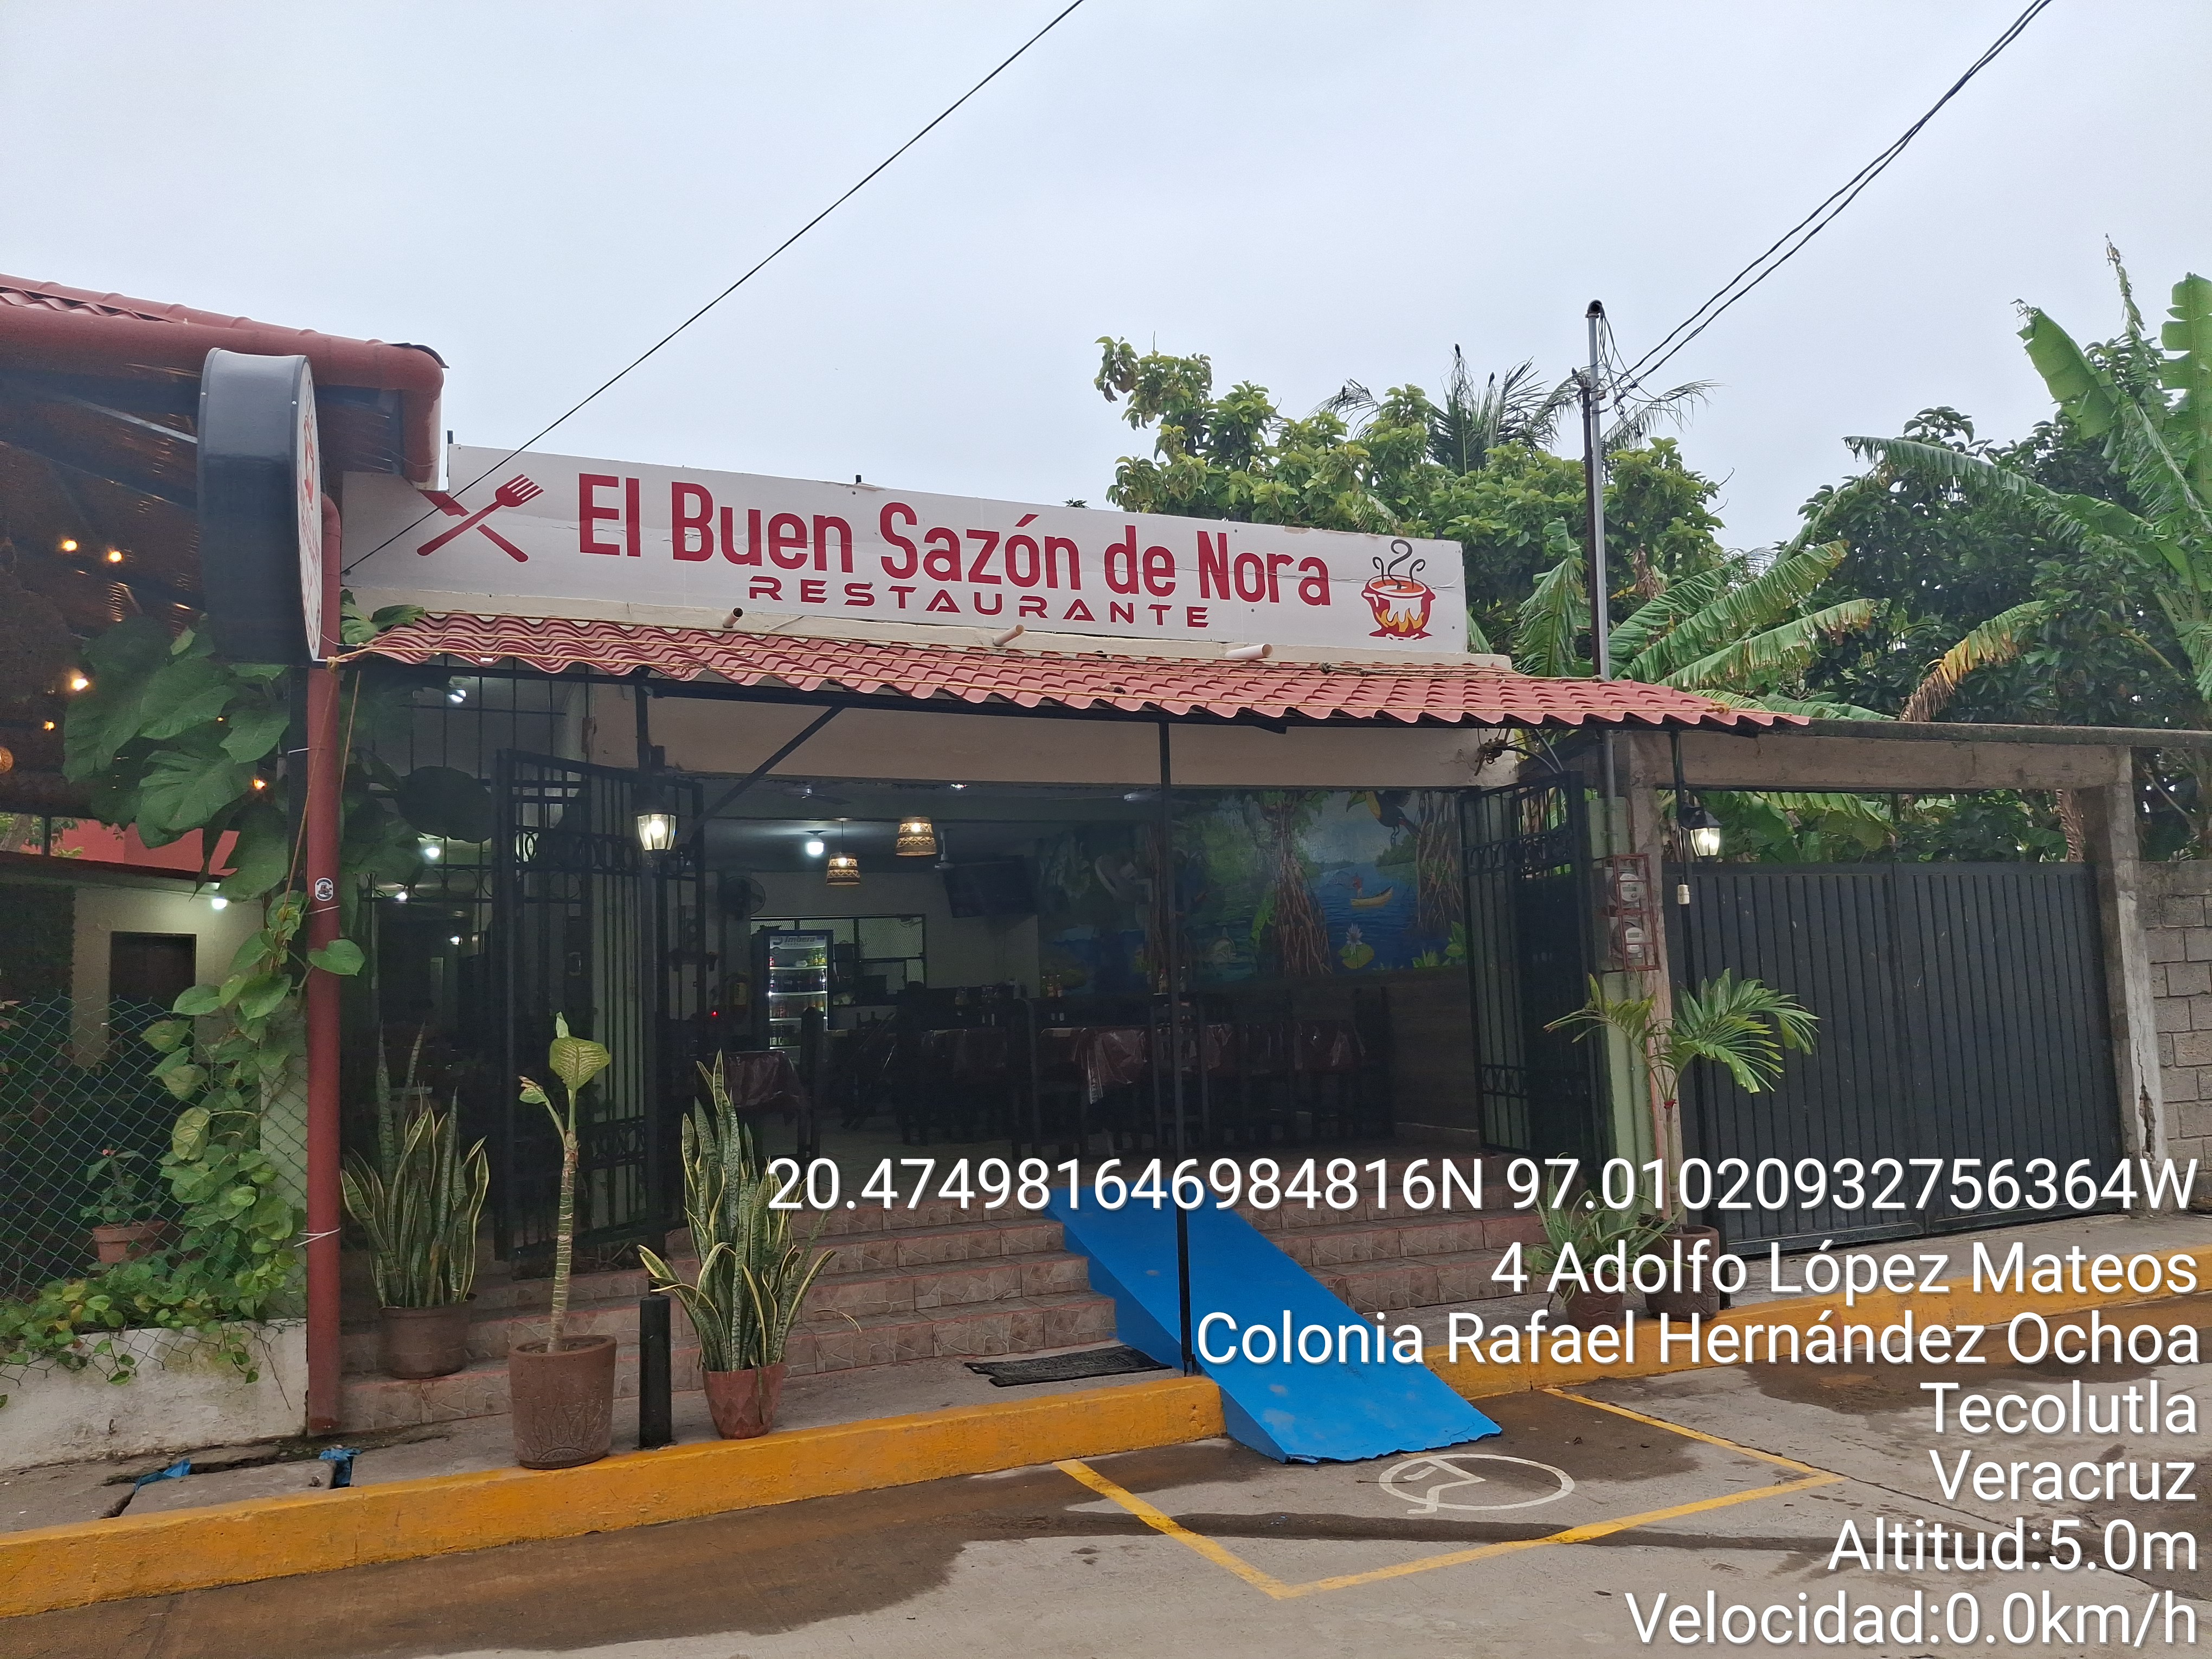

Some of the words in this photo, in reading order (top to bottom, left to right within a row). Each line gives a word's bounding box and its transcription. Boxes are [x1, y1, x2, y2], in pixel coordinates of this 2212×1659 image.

[579, 473, 641, 557] El
[671, 481, 853, 574] Buen
[879, 502, 1082, 591] Sazón
[1104, 525, 1176, 597] de
[1197, 530, 1332, 606] Nora
[749, 576, 1208, 628] RESTAURANTE
